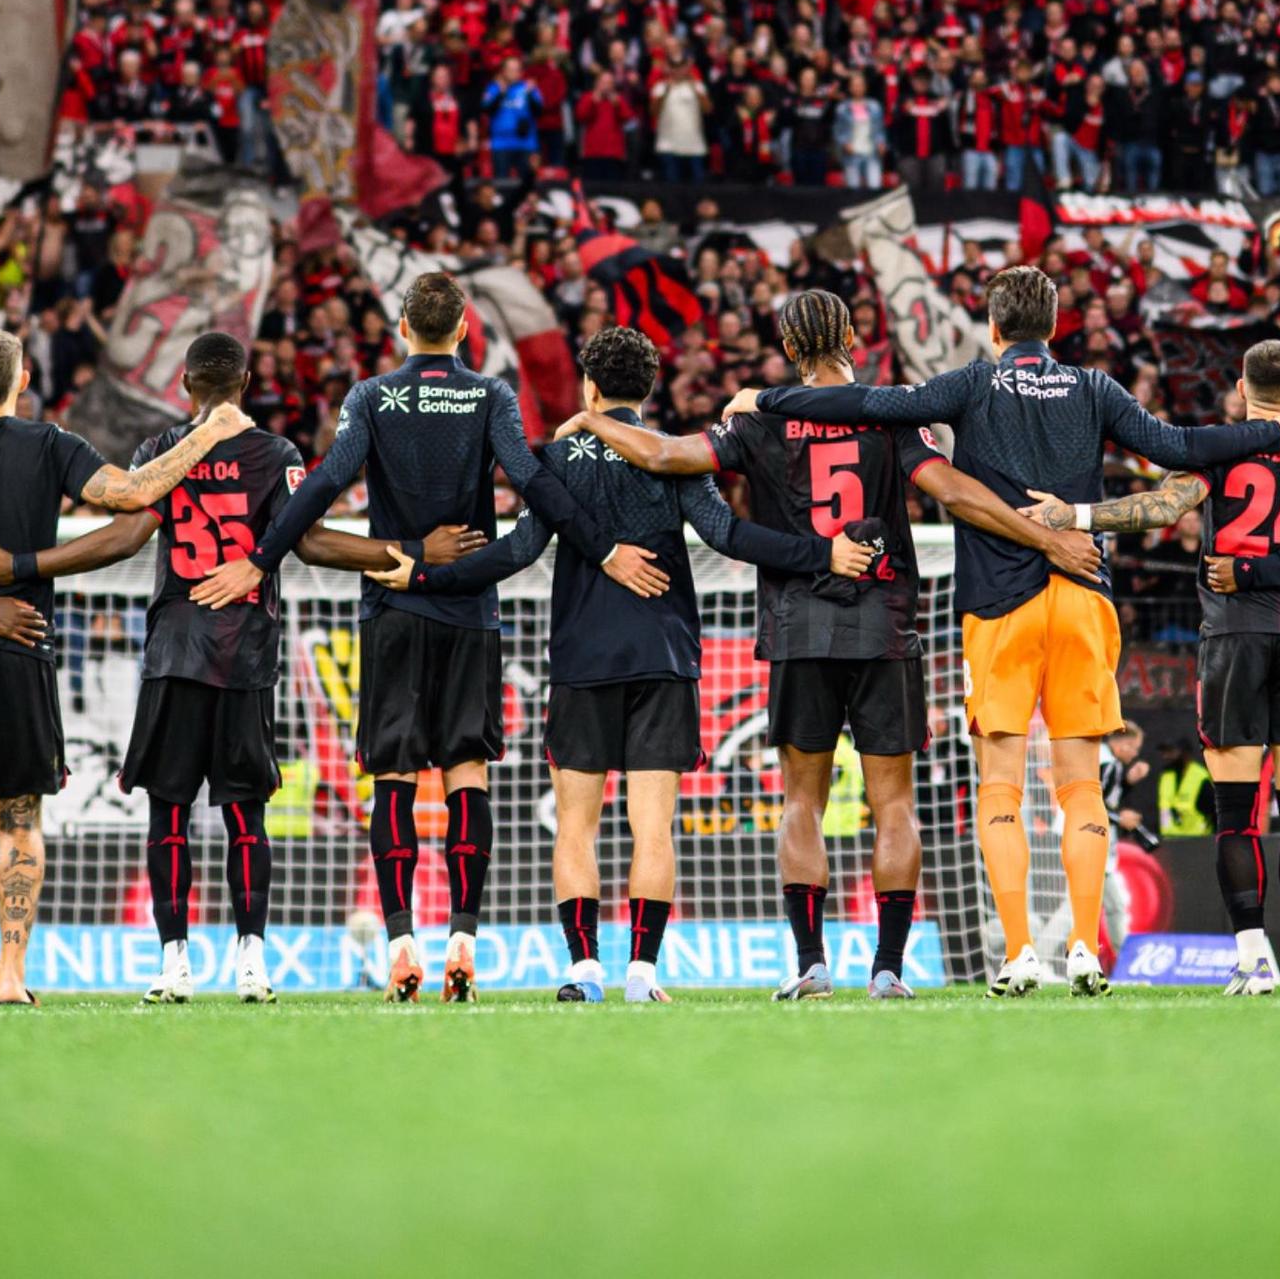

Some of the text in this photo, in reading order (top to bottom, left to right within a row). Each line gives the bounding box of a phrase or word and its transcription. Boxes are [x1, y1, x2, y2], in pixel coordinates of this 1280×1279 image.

[418, 399, 478, 414] Gothaer
[419, 385, 487, 399] Barmenia
[786, 420, 852, 439] BAYER
[213, 461, 240, 481] 04
[809, 441, 864, 539] 5
[170, 485, 256, 580] 35
[340, 927, 606, 983] NEDA
[663, 927, 933, 982] NIEAX
